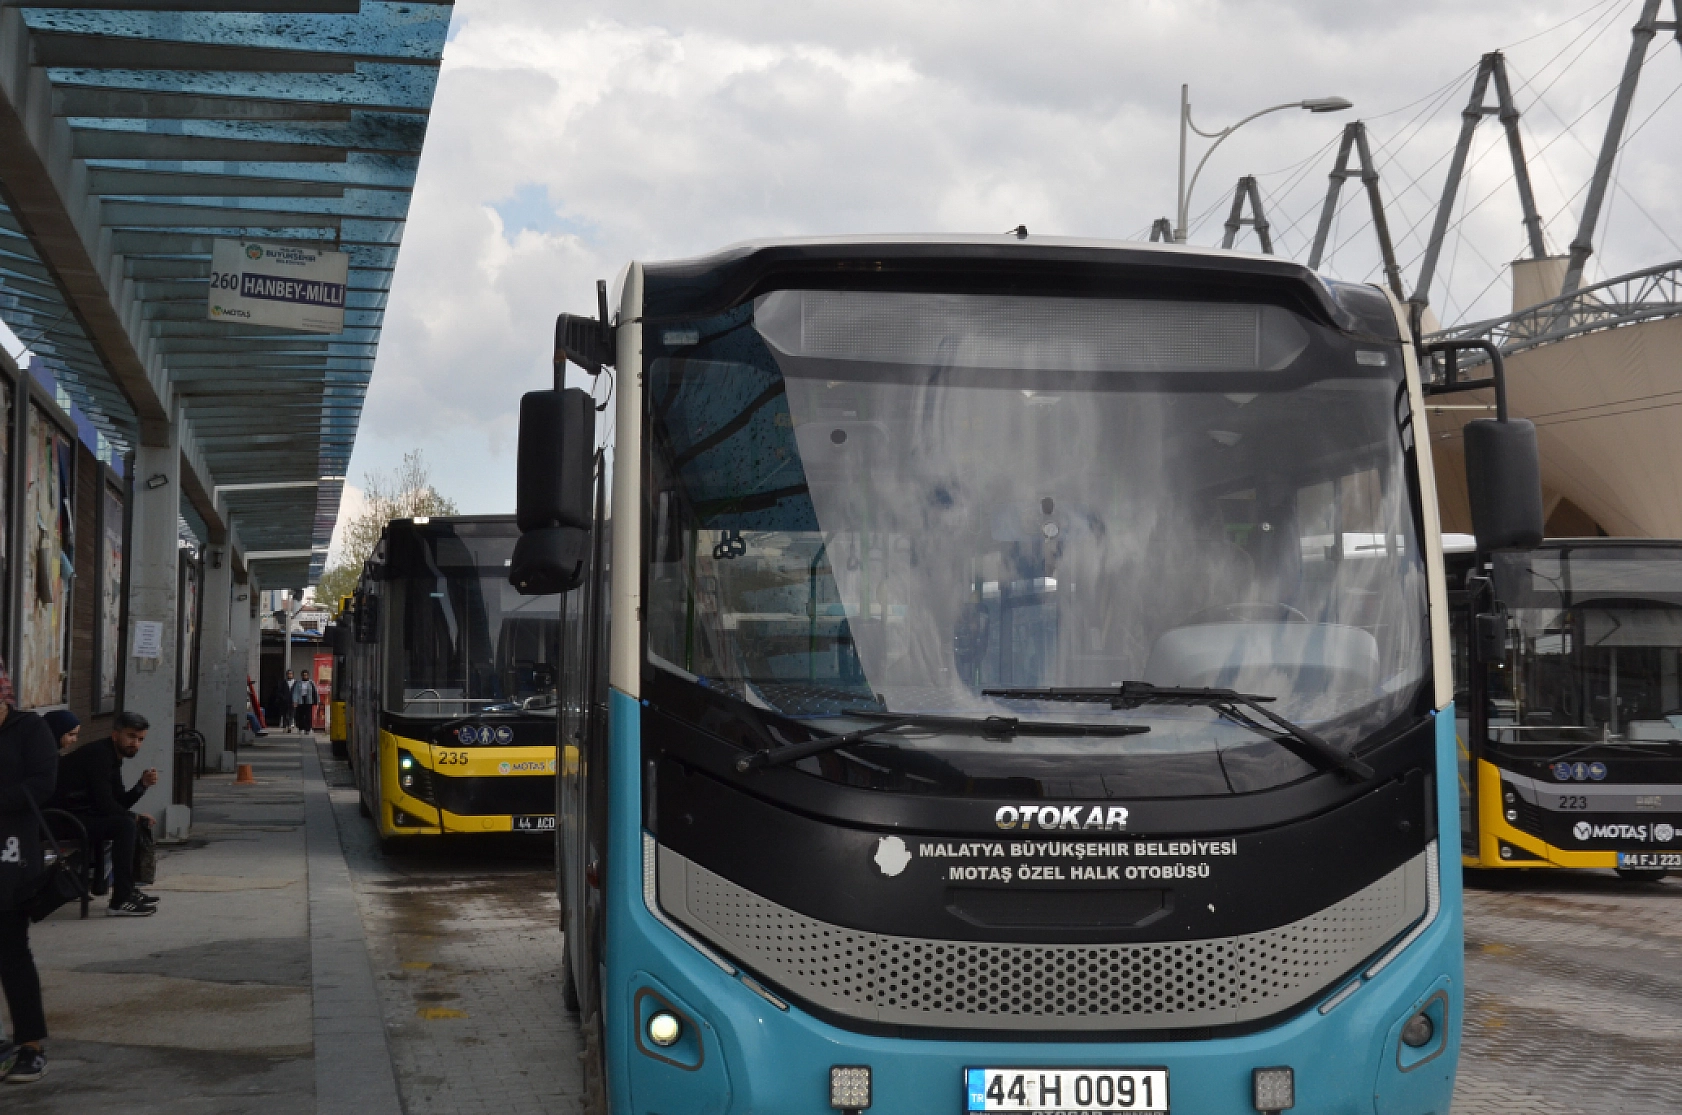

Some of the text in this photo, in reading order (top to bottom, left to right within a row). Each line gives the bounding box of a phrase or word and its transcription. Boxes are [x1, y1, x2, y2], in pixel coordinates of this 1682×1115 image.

[211, 272, 239, 290] 260
[438, 751, 469, 765] 235
[1559, 795, 1588, 811] 223
[518, 816, 532, 828] 44
[995, 805, 1129, 830] OTOKAR
[1592, 824, 1647, 842] MOTAŞ
[919, 842, 1005, 858] MALATYA
[1133, 838, 1238, 857] BELEDİYESİ
[1624, 854, 1637, 866] 44
[1640, 854, 1657, 866] FJ
[949, 862, 1211, 884] MOTAŞ ÖZEL HALK OTOBÜSÜ
[986, 1073, 1026, 1106] 44
[1039, 1073, 1063, 1106] H
[1075, 1074, 1153, 1107] 0091
